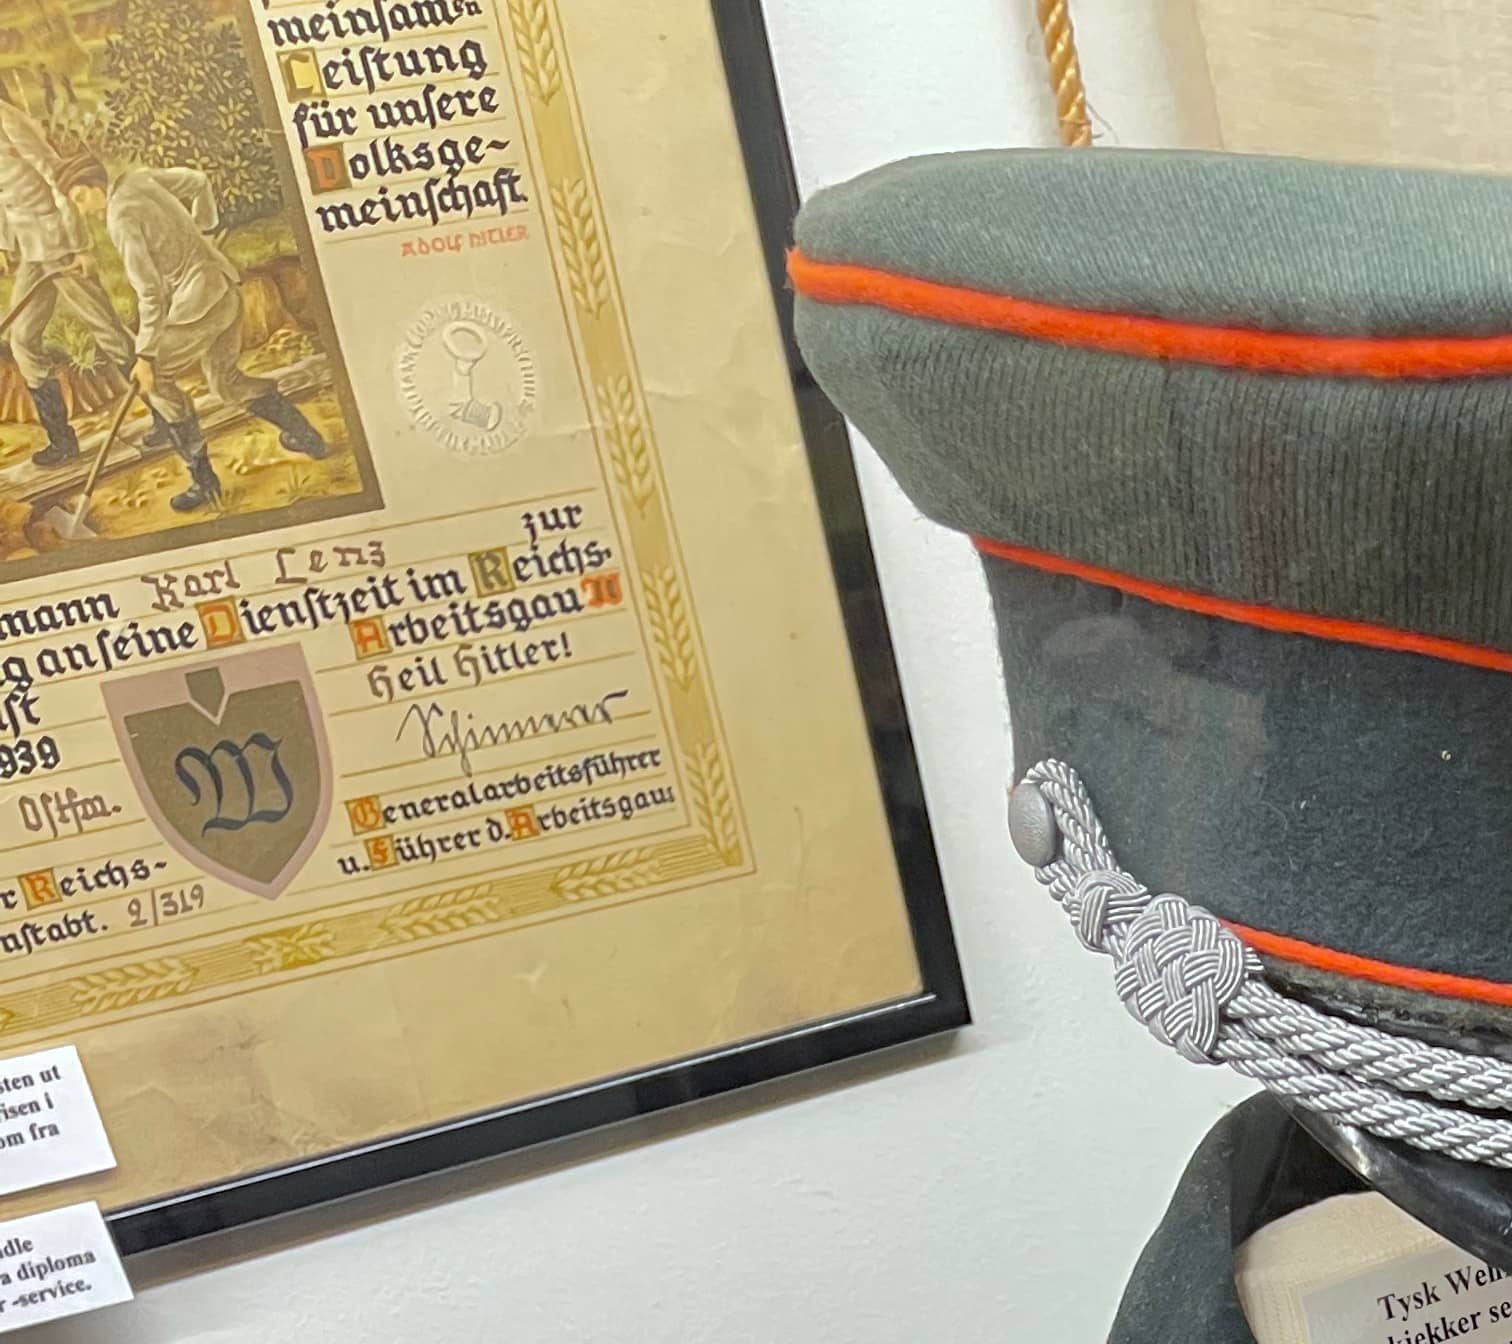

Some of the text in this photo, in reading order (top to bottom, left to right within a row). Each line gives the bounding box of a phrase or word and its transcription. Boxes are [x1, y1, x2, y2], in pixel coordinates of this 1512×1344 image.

[292, 84, 499, 148] für unsere
[141, 560, 240, 612] Karl
[275, 541, 386, 584] Lenz
[522, 504, 582, 542] zur
[407, 567, 467, 602] im
[367, 632, 572, 701] Heil Hitler!
[345, 749, 660, 836] Generalarbeitsführer
[364, 831, 480, 872] Führer
[39, 1065, 61, 1083] ut
[29, 1123, 60, 1141] fra
[0, 1238, 33, 1259] dle
[17, 1251, 96, 1281] diploma
[1377, 1281, 1441, 1321] Tysk
